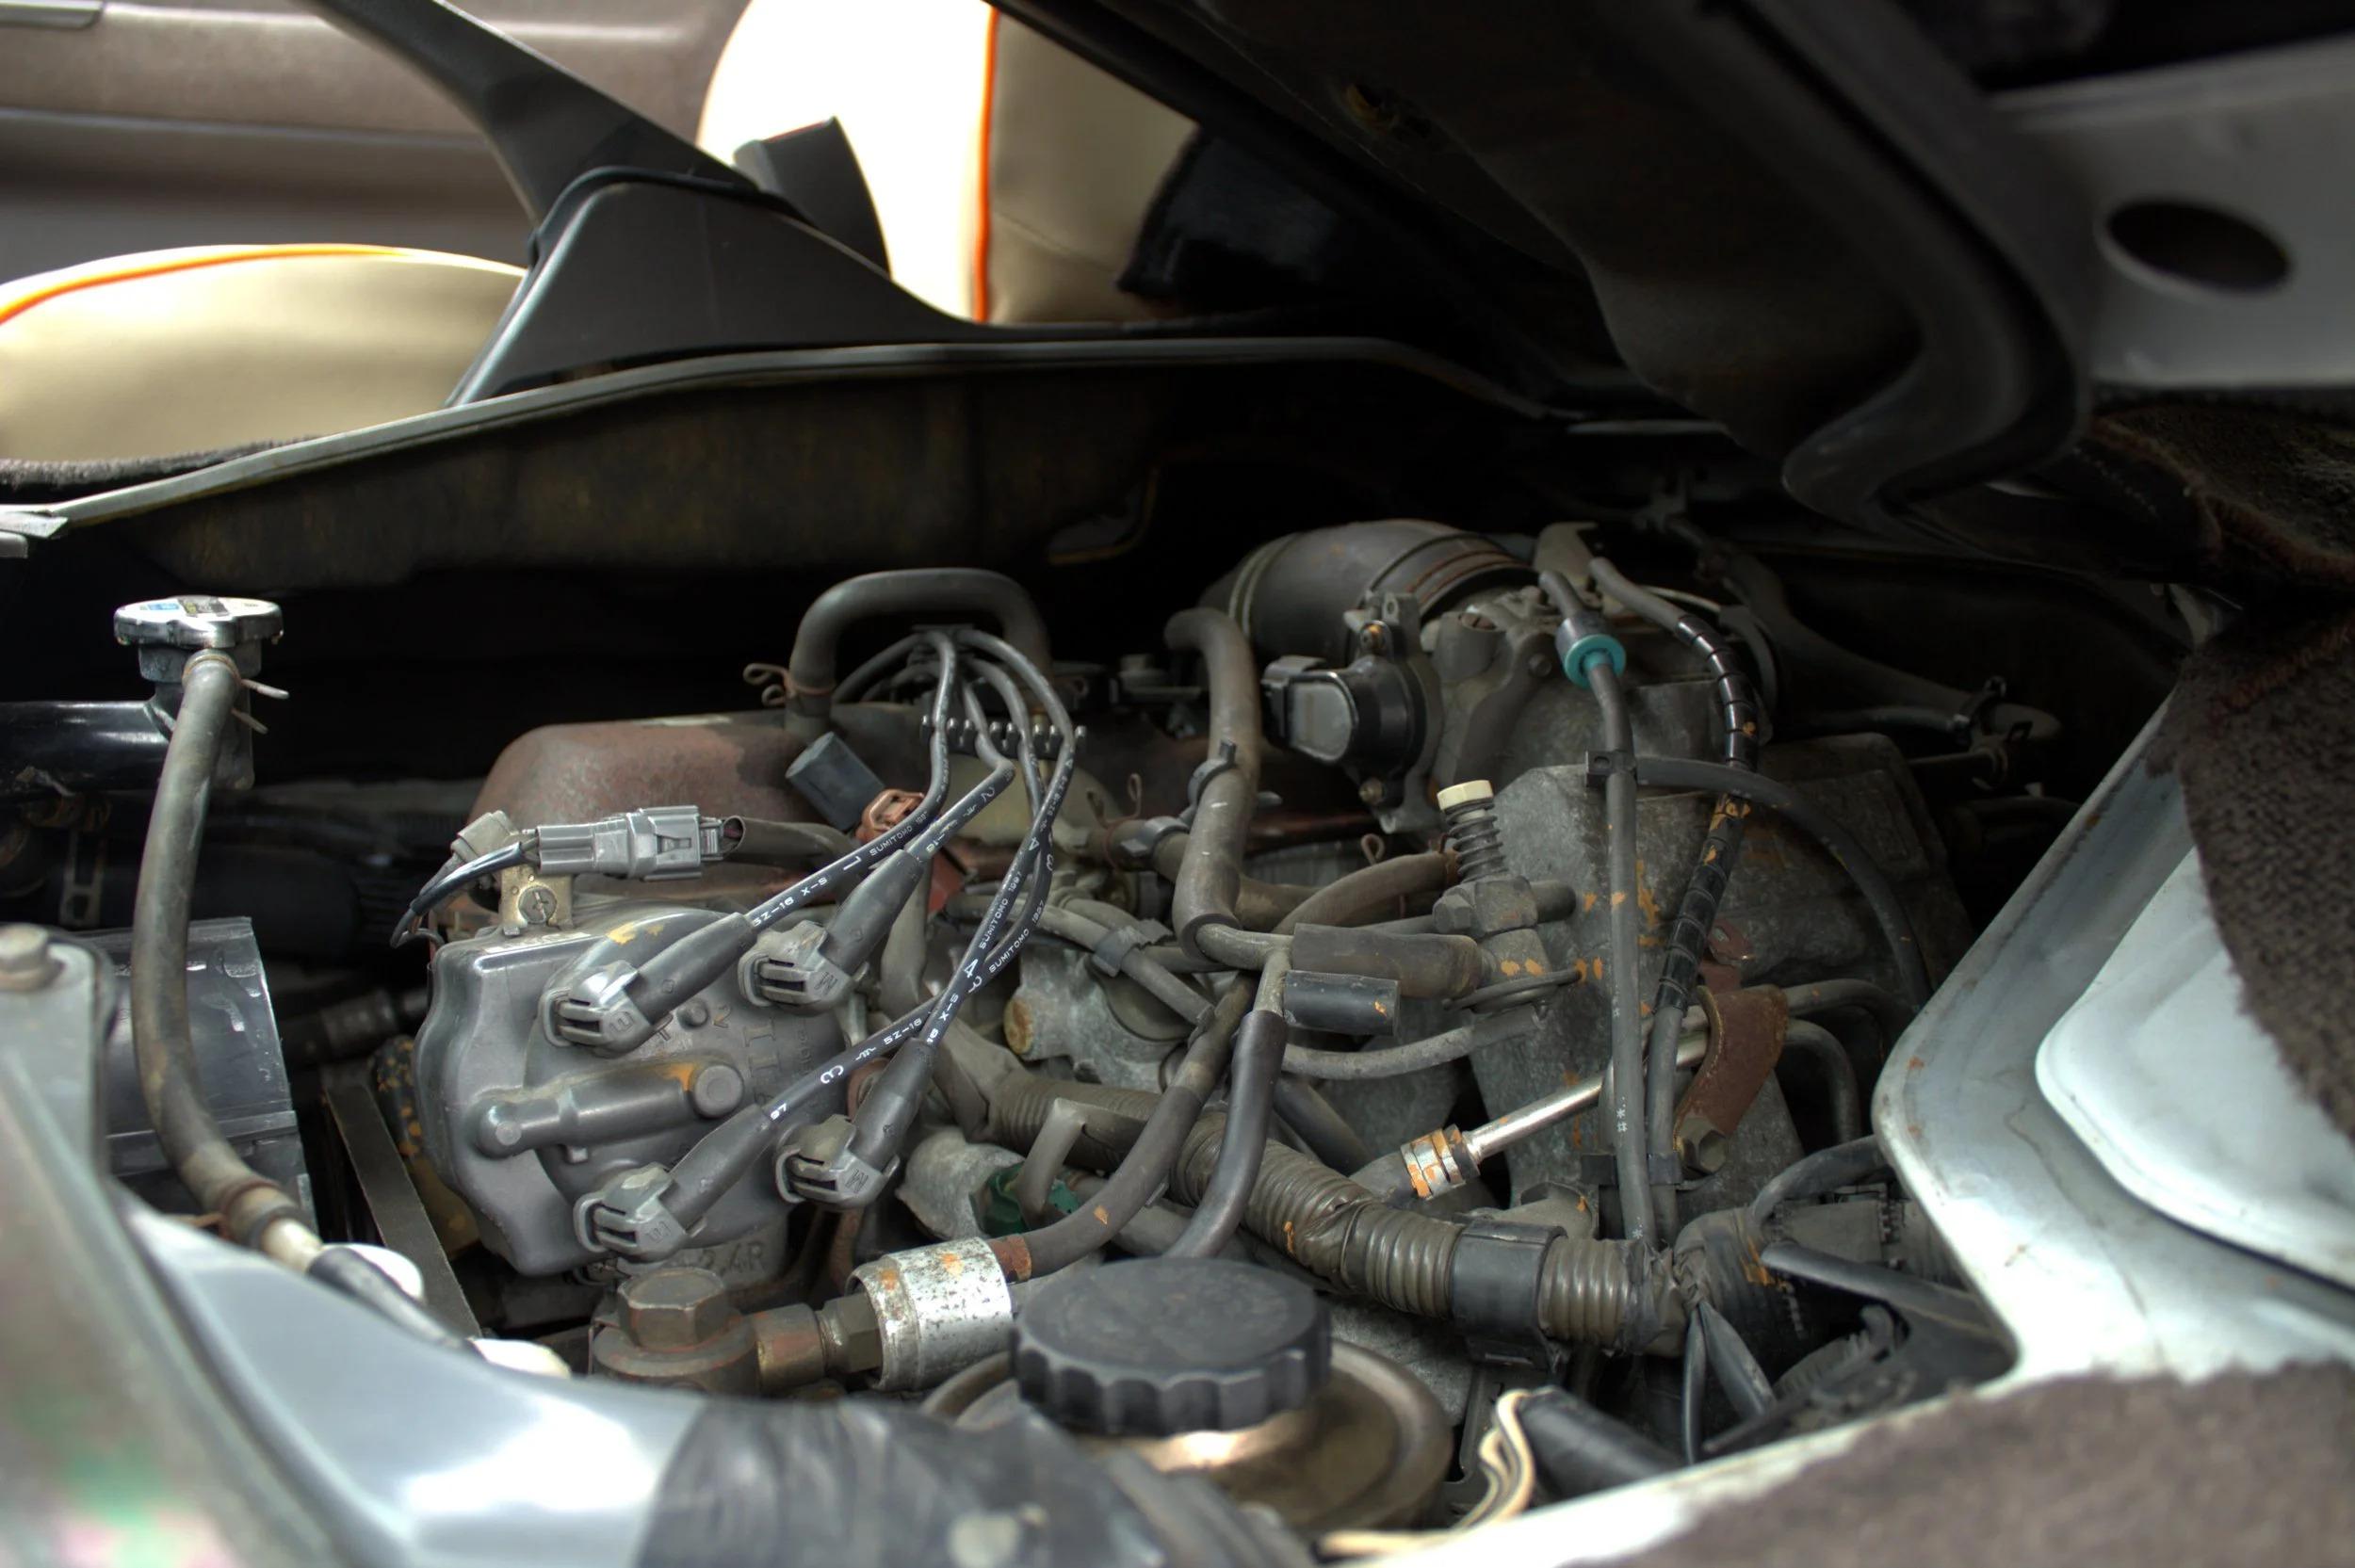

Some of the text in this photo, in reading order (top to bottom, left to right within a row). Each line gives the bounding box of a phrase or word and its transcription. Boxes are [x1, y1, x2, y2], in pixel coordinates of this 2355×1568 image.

[981, 787, 996, 802] 2
[801, 877, 828, 897] X-S
[869, 826, 914, 857] SUMITOMO
[820, 1065, 844, 1084] 3
[989, 929, 1031, 974] SUMITOMO
[938, 993, 959, 1022] X-S
[964, 959, 979, 978] 4
[979, 898, 1009, 950] SUMITOMO
